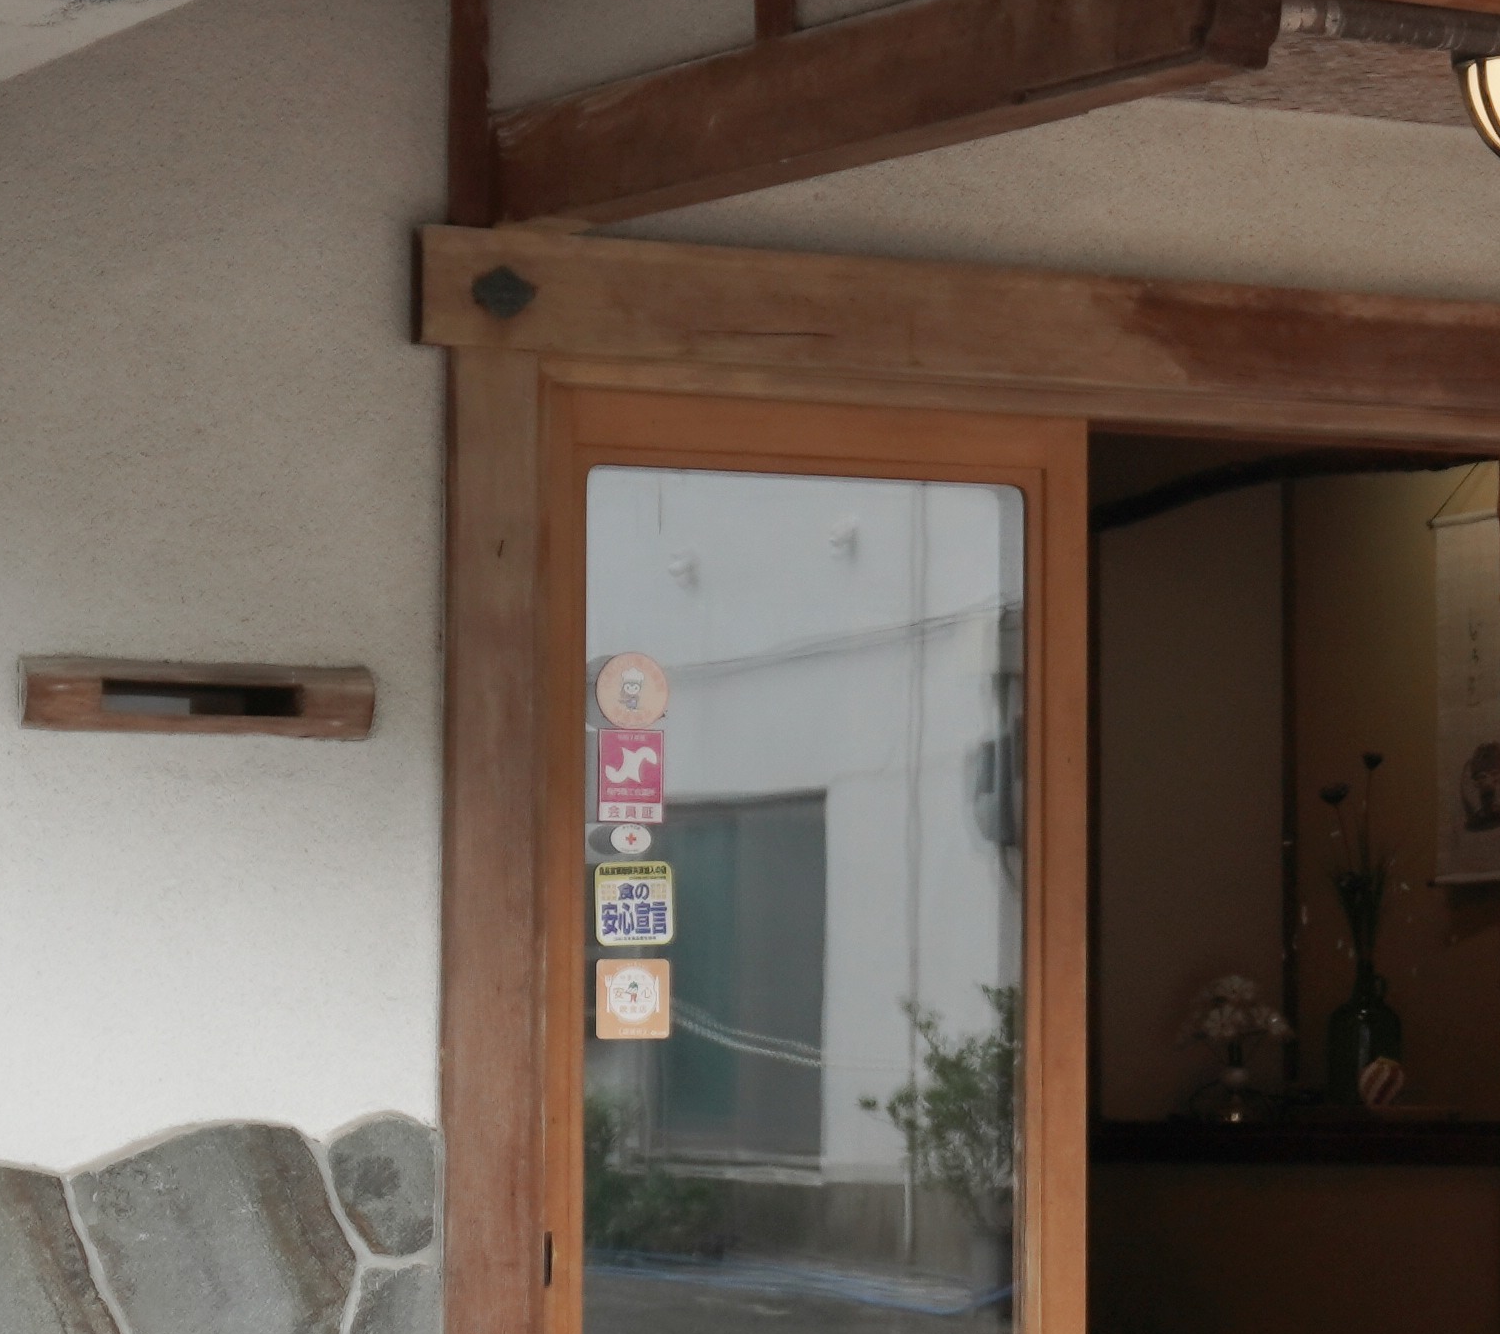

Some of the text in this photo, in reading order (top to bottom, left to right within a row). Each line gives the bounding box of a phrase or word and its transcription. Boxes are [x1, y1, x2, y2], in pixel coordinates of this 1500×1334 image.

[608, 805, 654, 819] 会員証
[617, 883, 650, 901] 食の
[601, 901, 668, 936] 安心宣言
